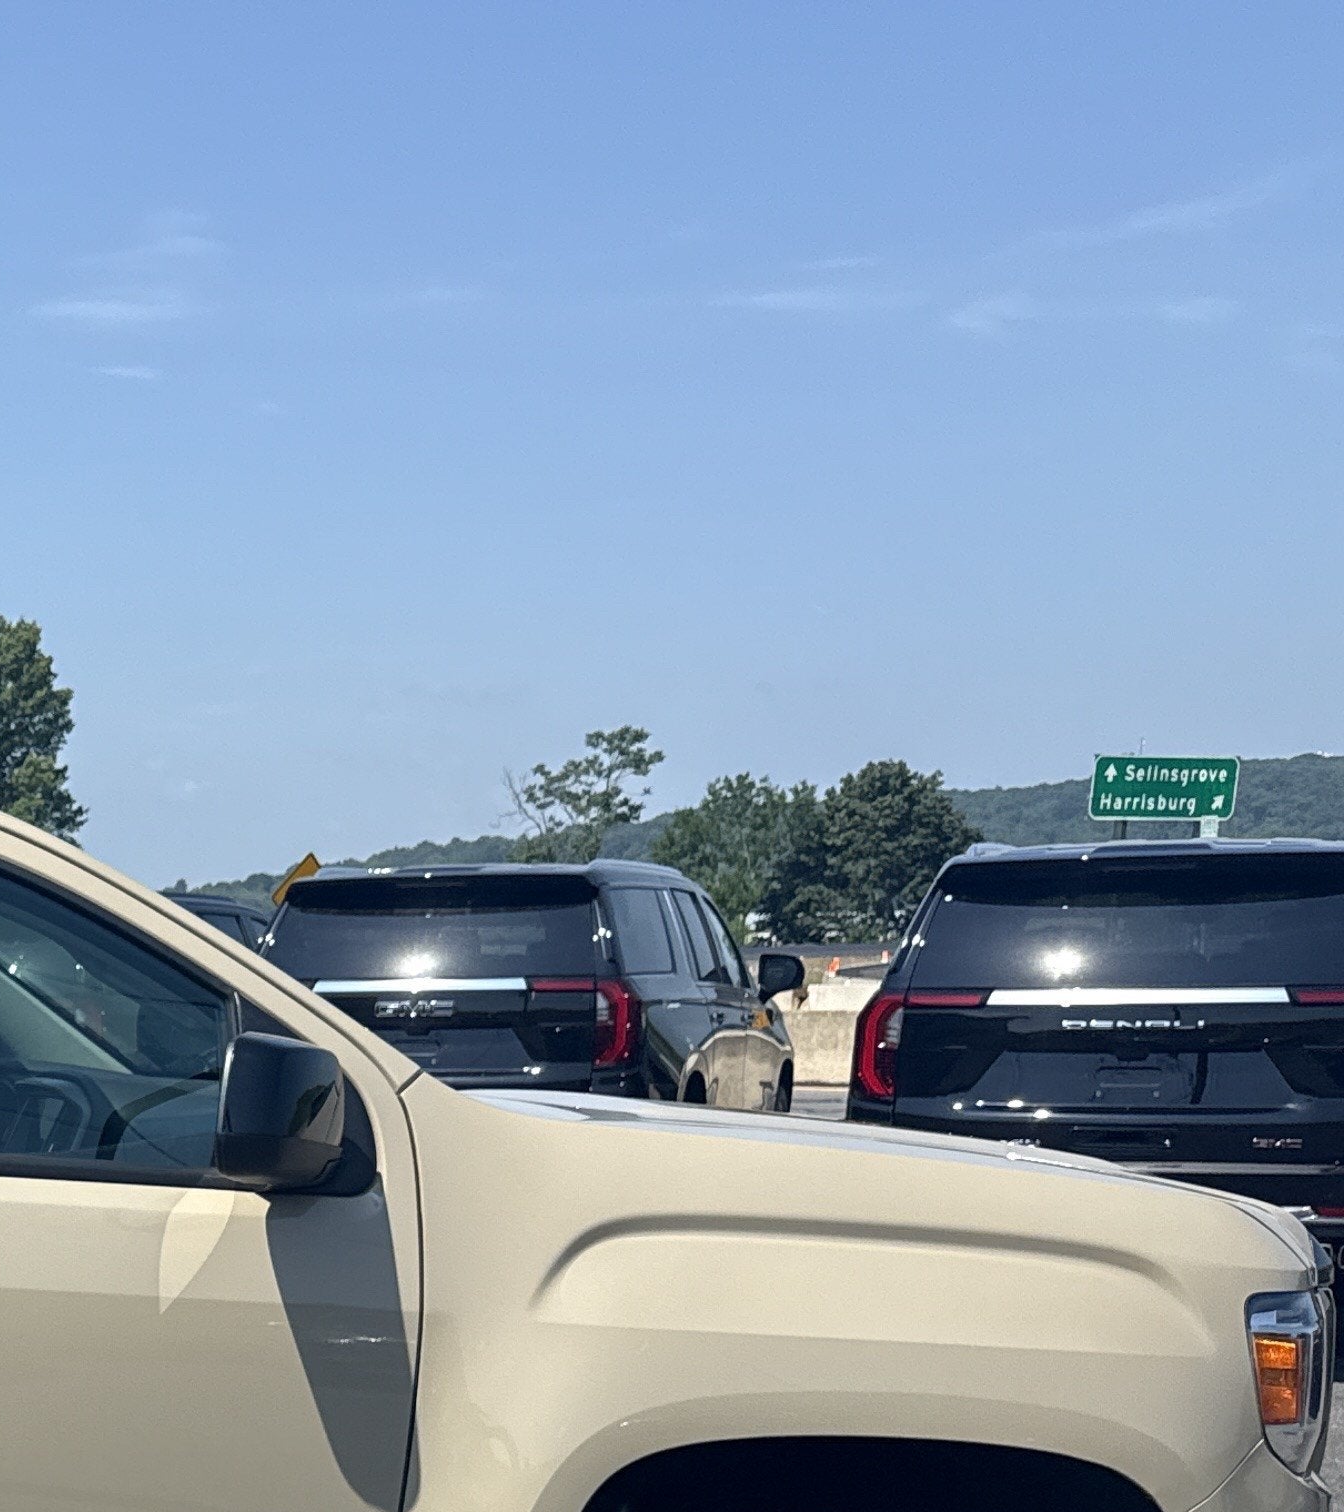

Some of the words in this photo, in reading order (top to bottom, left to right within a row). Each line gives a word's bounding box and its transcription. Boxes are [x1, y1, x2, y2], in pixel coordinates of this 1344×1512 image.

[1124, 764, 1228, 787] Selinsgrove
[1099, 793, 1196, 816] Harrisburg
[374, 999, 454, 1018] GMC
[1061, 1019, 1205, 1030] DENALI
